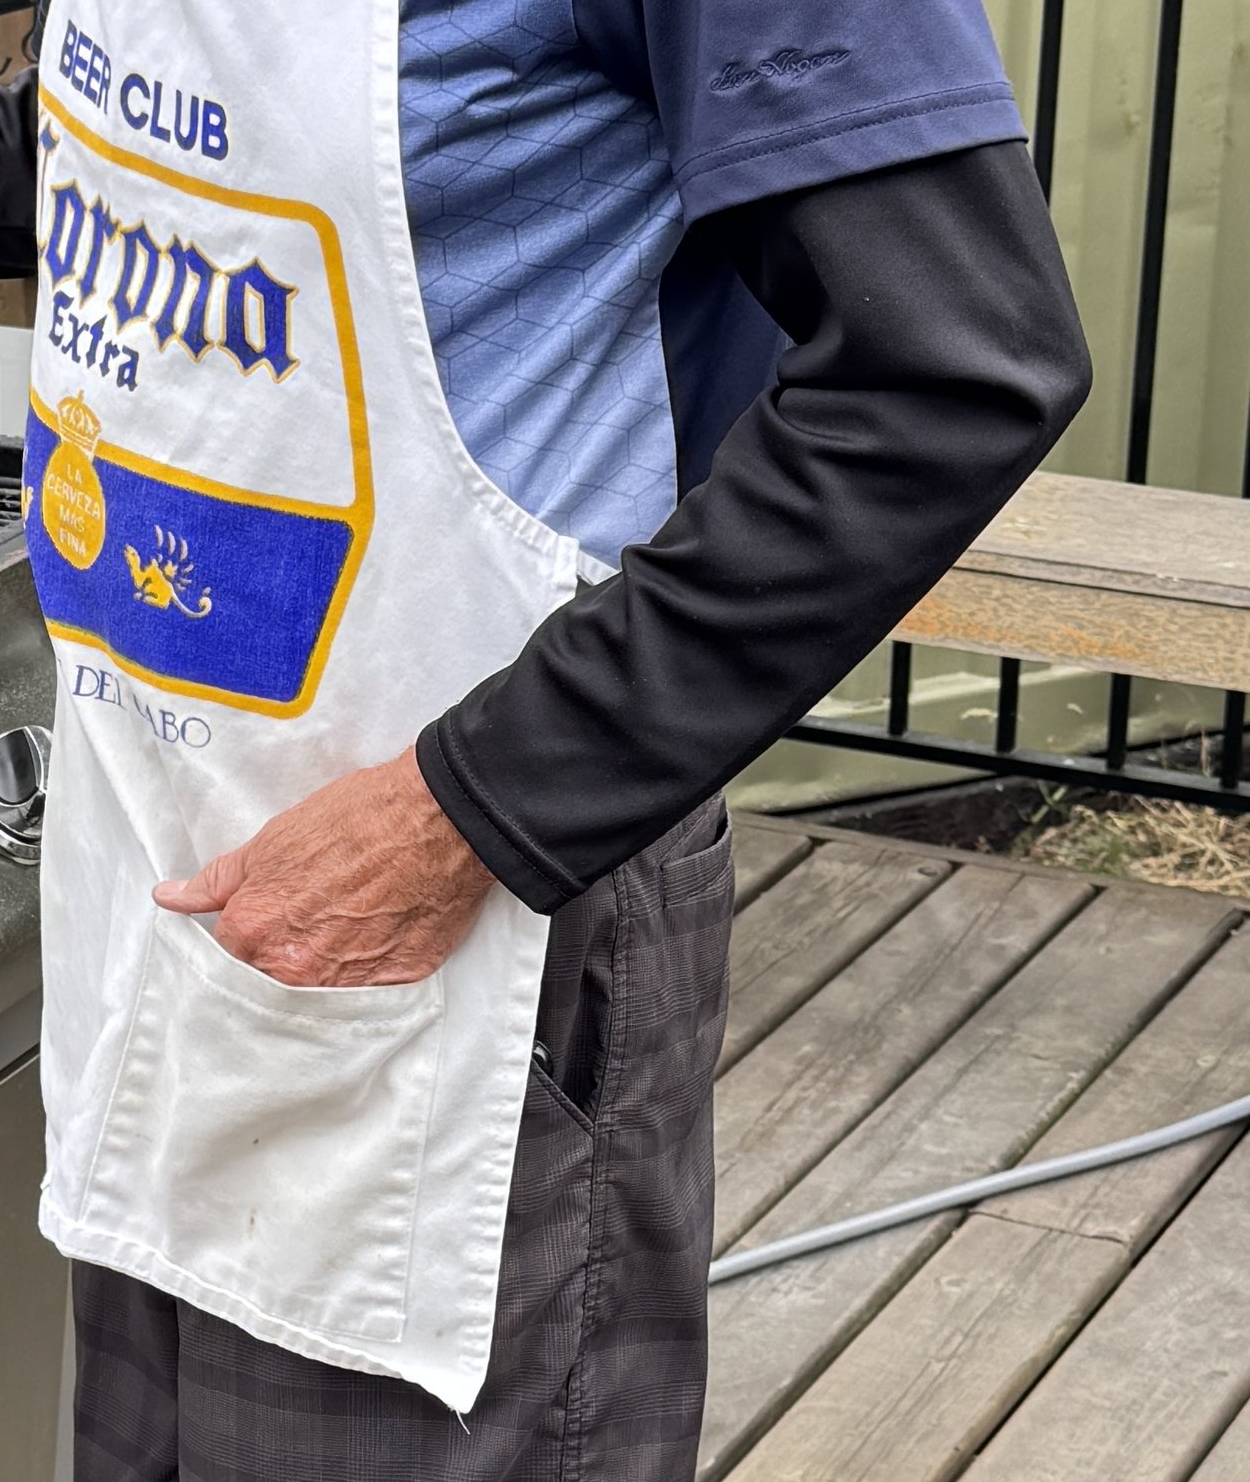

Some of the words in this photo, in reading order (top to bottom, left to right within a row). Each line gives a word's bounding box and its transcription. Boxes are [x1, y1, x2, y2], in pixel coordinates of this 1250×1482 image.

[59, 19, 112, 115] BEER
[120, 73, 229, 161] CLUB
[49, 291, 141, 393] Extra
[47, 473, 102, 521] CERVEZA
[65, 463, 83, 486] LA
[58, 528, 87, 556] FINA
